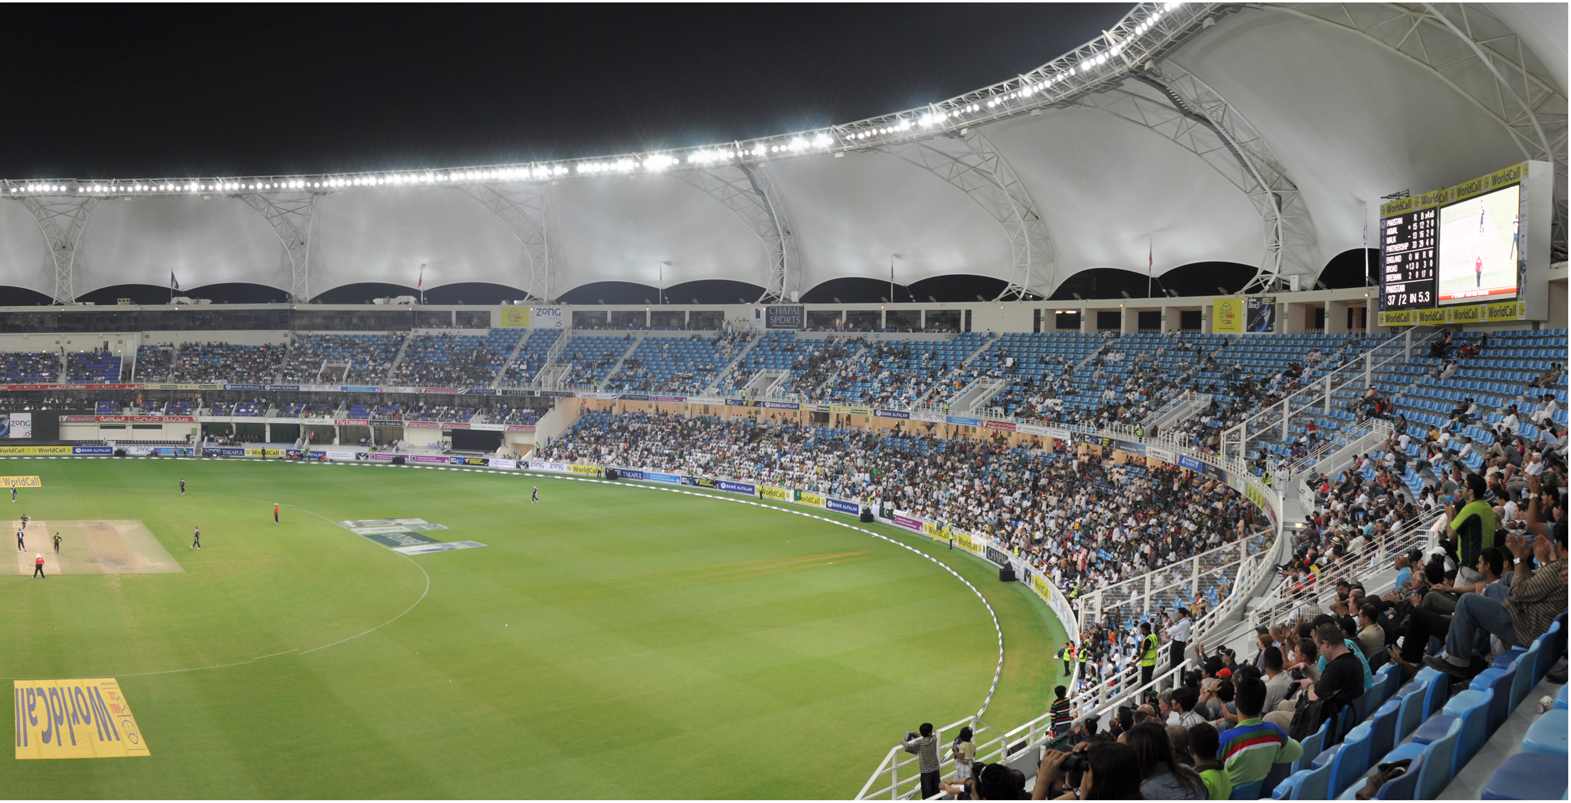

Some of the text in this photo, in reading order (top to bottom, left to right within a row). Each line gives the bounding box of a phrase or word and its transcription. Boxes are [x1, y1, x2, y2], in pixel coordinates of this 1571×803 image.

[1492, 166, 1521, 186] WorldCall
[1457, 180, 1481, 197] WorldCall
[1421, 191, 1448, 205] WorldCall
[1387, 199, 1411, 214] WorldCall
[1387, 294, 1395, 305] 37
[1409, 293, 1417, 303] IN
[1418, 291, 1430, 302] 5.3
[769, 307, 801, 315] CHAPAL
[1385, 304, 1517, 323] WorldCall WorldCall WorldCall WorldCall
[770, 316, 801, 324] SPORTS
[3, 477, 40, 486] WorldCall
[801, 495, 820, 506] orldCall
[929, 526, 950, 539] WorldCall
[15, 686, 120, 747] WorldCall
